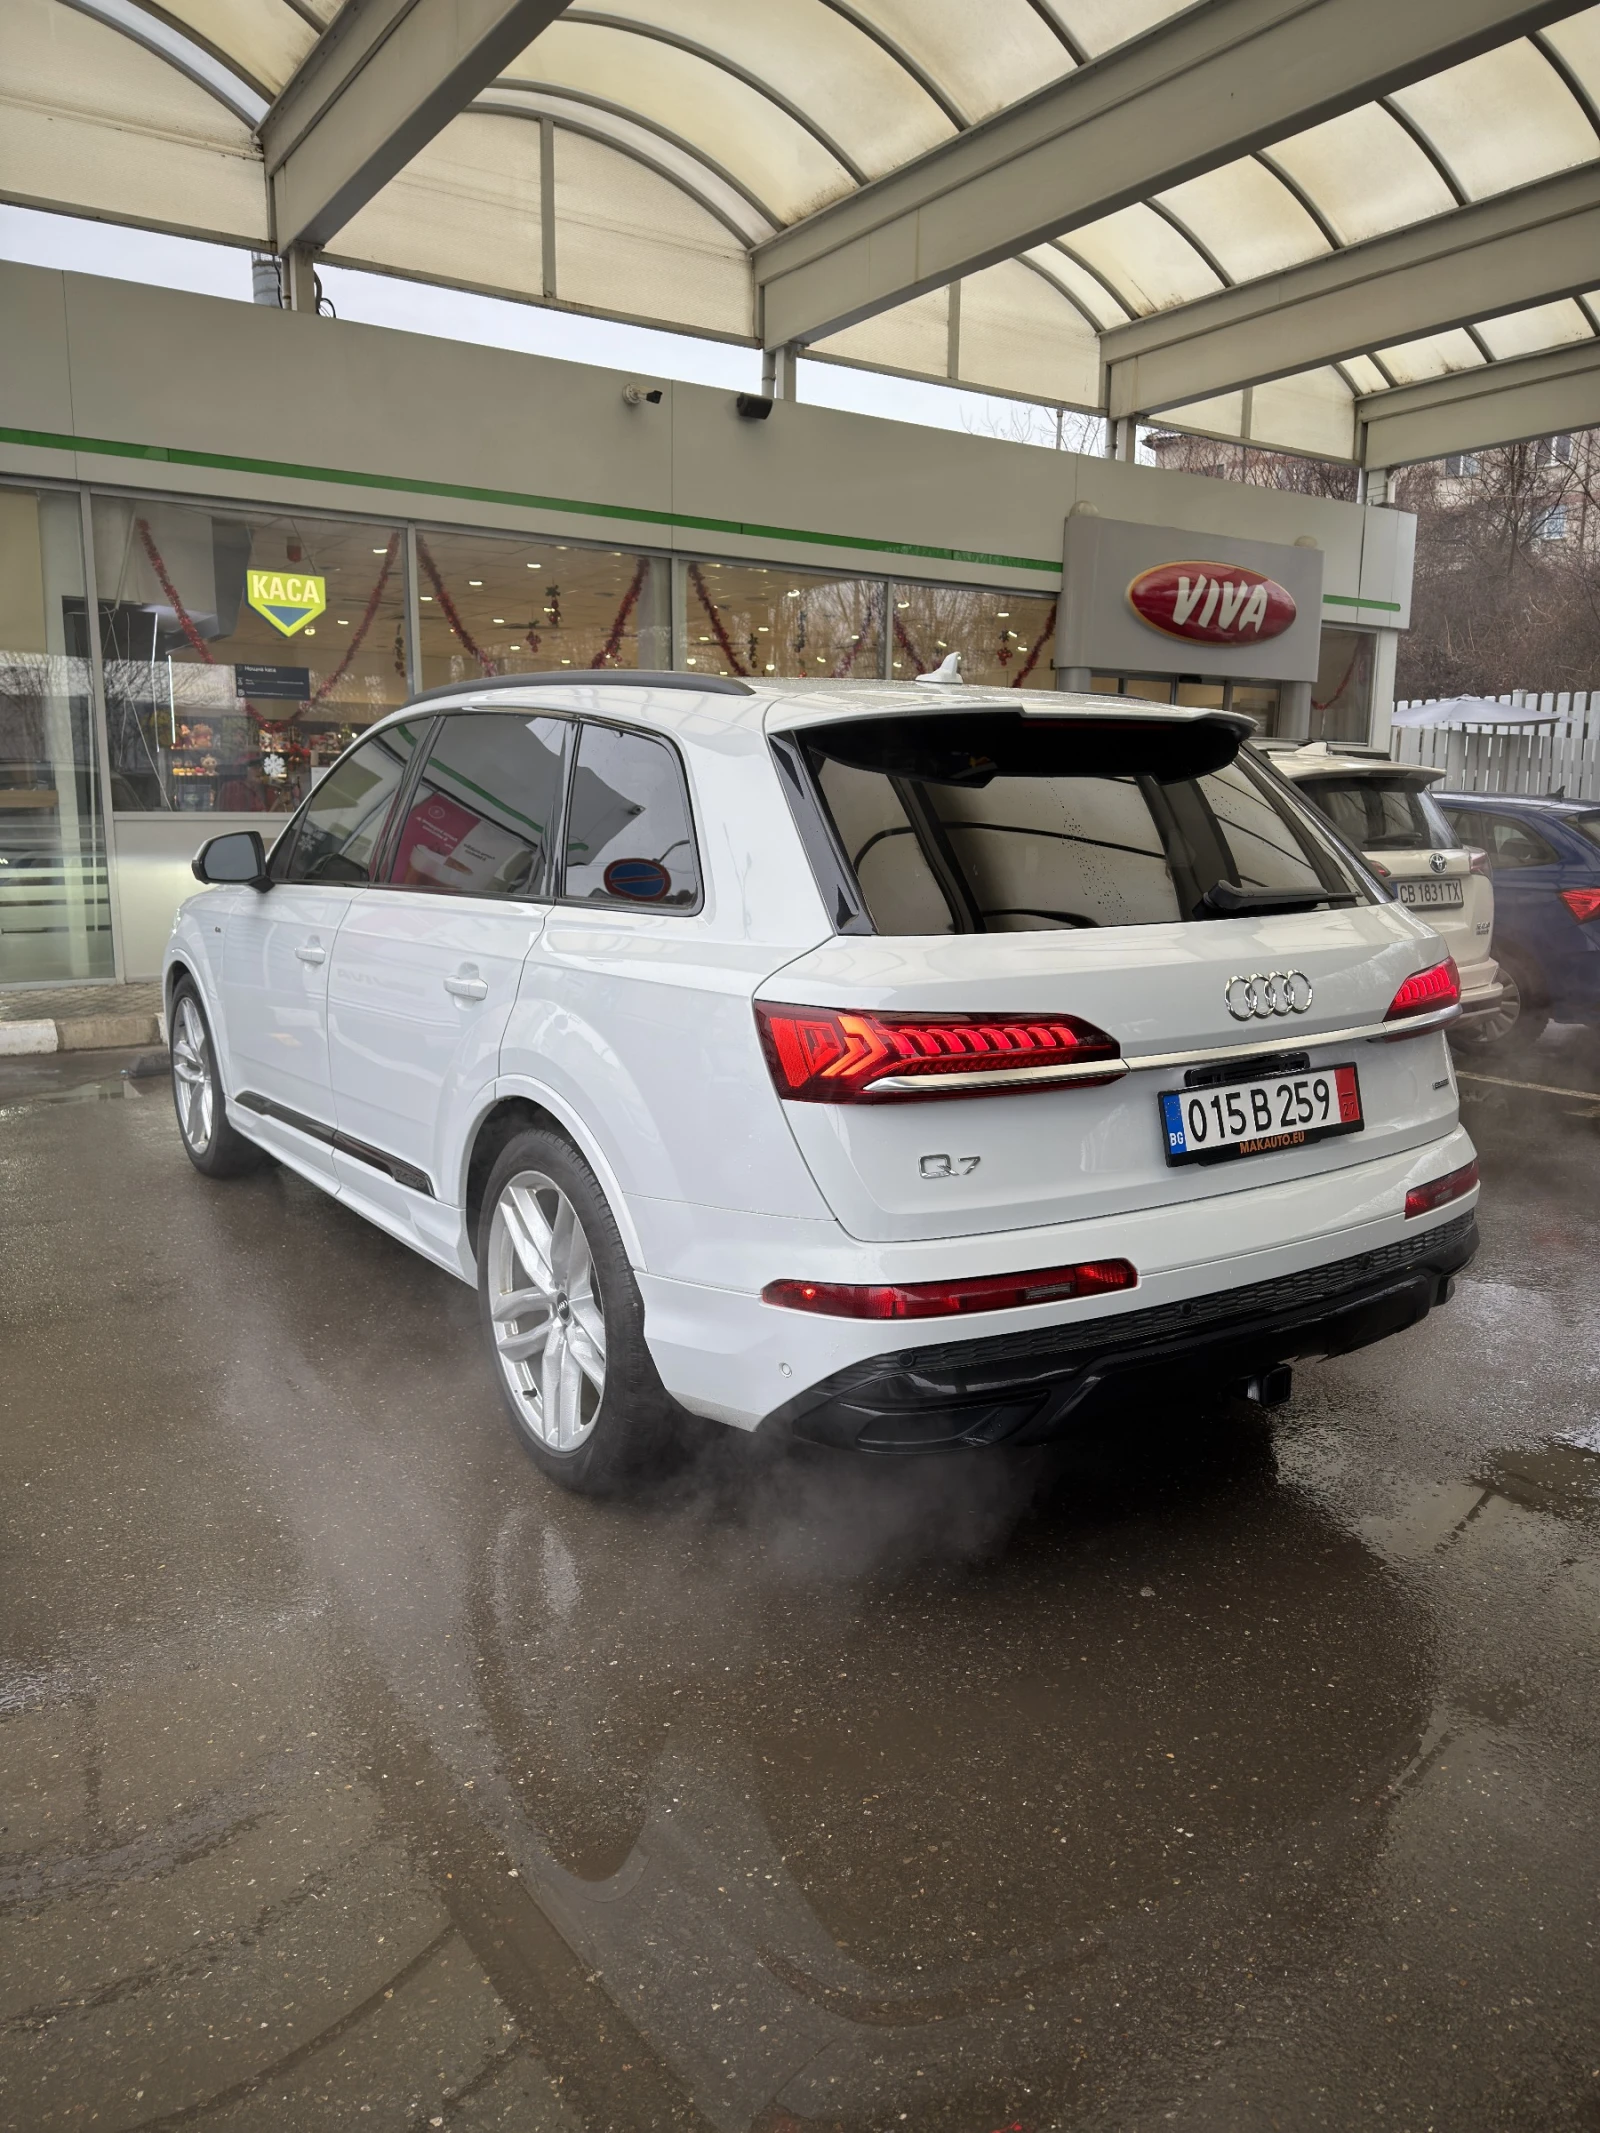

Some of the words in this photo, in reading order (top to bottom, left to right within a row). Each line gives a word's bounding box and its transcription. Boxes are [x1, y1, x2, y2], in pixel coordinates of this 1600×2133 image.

[252, 574, 321, 604] КАСА
[1172, 574, 1268, 633] VIVA
[1400, 884, 1416, 903] CB
[1418, 883, 1444, 902] 1831
[1445, 882, 1460, 901] TX
[1343, 1101, 1356, 1117] 27
[1169, 1131, 1184, 1146] BG
[1239, 1130, 1306, 1155] MAKAUTO.EU
[918, 1153, 981, 1179] Q7
